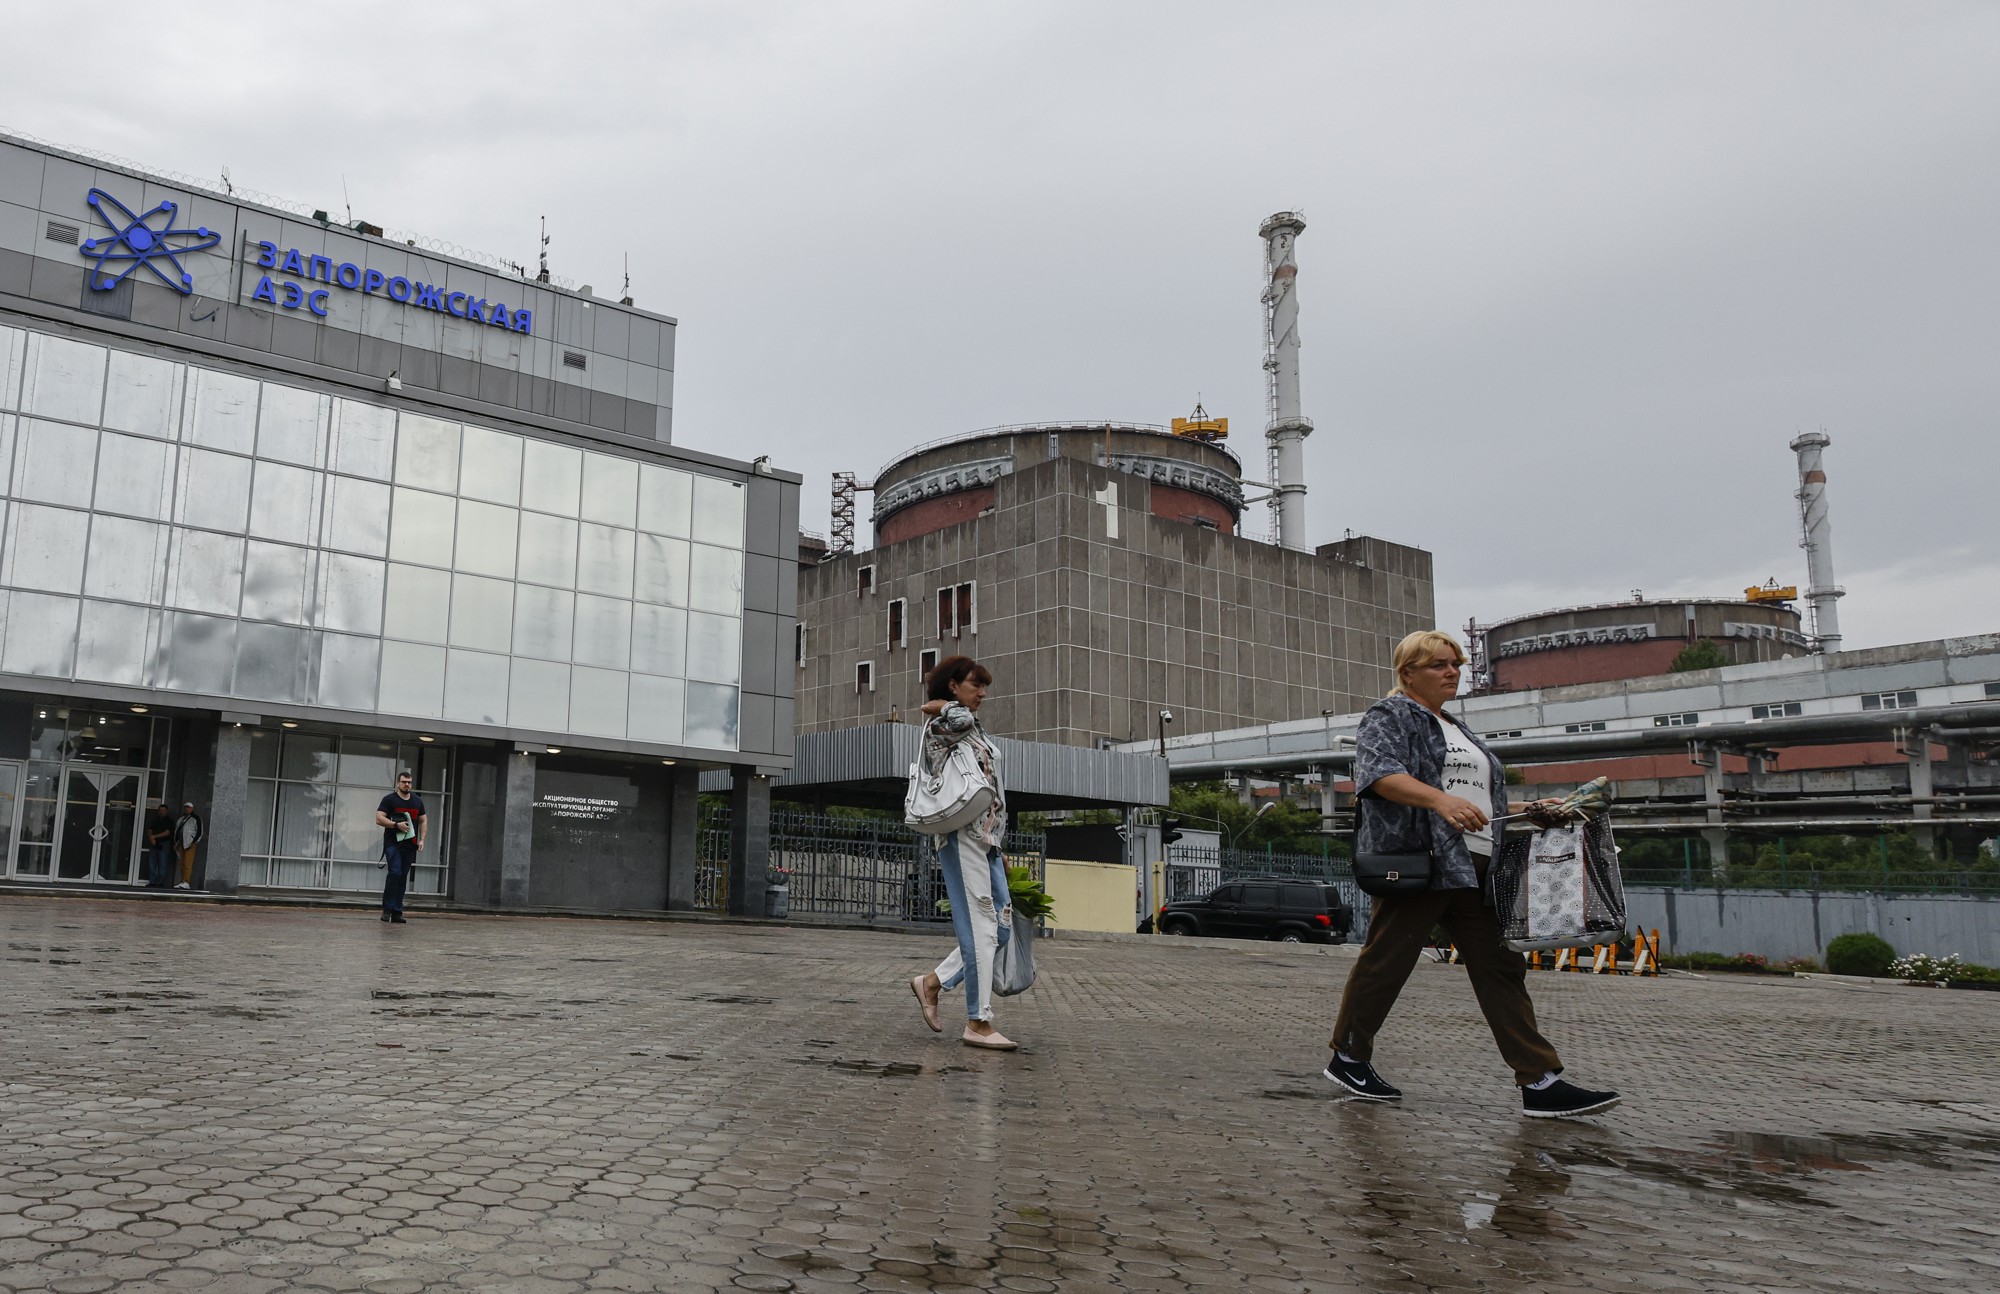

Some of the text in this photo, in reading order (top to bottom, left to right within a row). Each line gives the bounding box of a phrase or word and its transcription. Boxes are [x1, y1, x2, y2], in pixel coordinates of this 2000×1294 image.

[252, 275, 330, 317] АЭС
[257, 240, 532, 335] ЗАПОРОЖСКАЯ
[1095, 480, 1119, 540] 1
[1446, 742, 1470, 754] ion
[1446, 778, 1470, 790] you
[543, 794, 619, 807] АКЦИОНЕРНОЕ ОБЩЕСТВО
